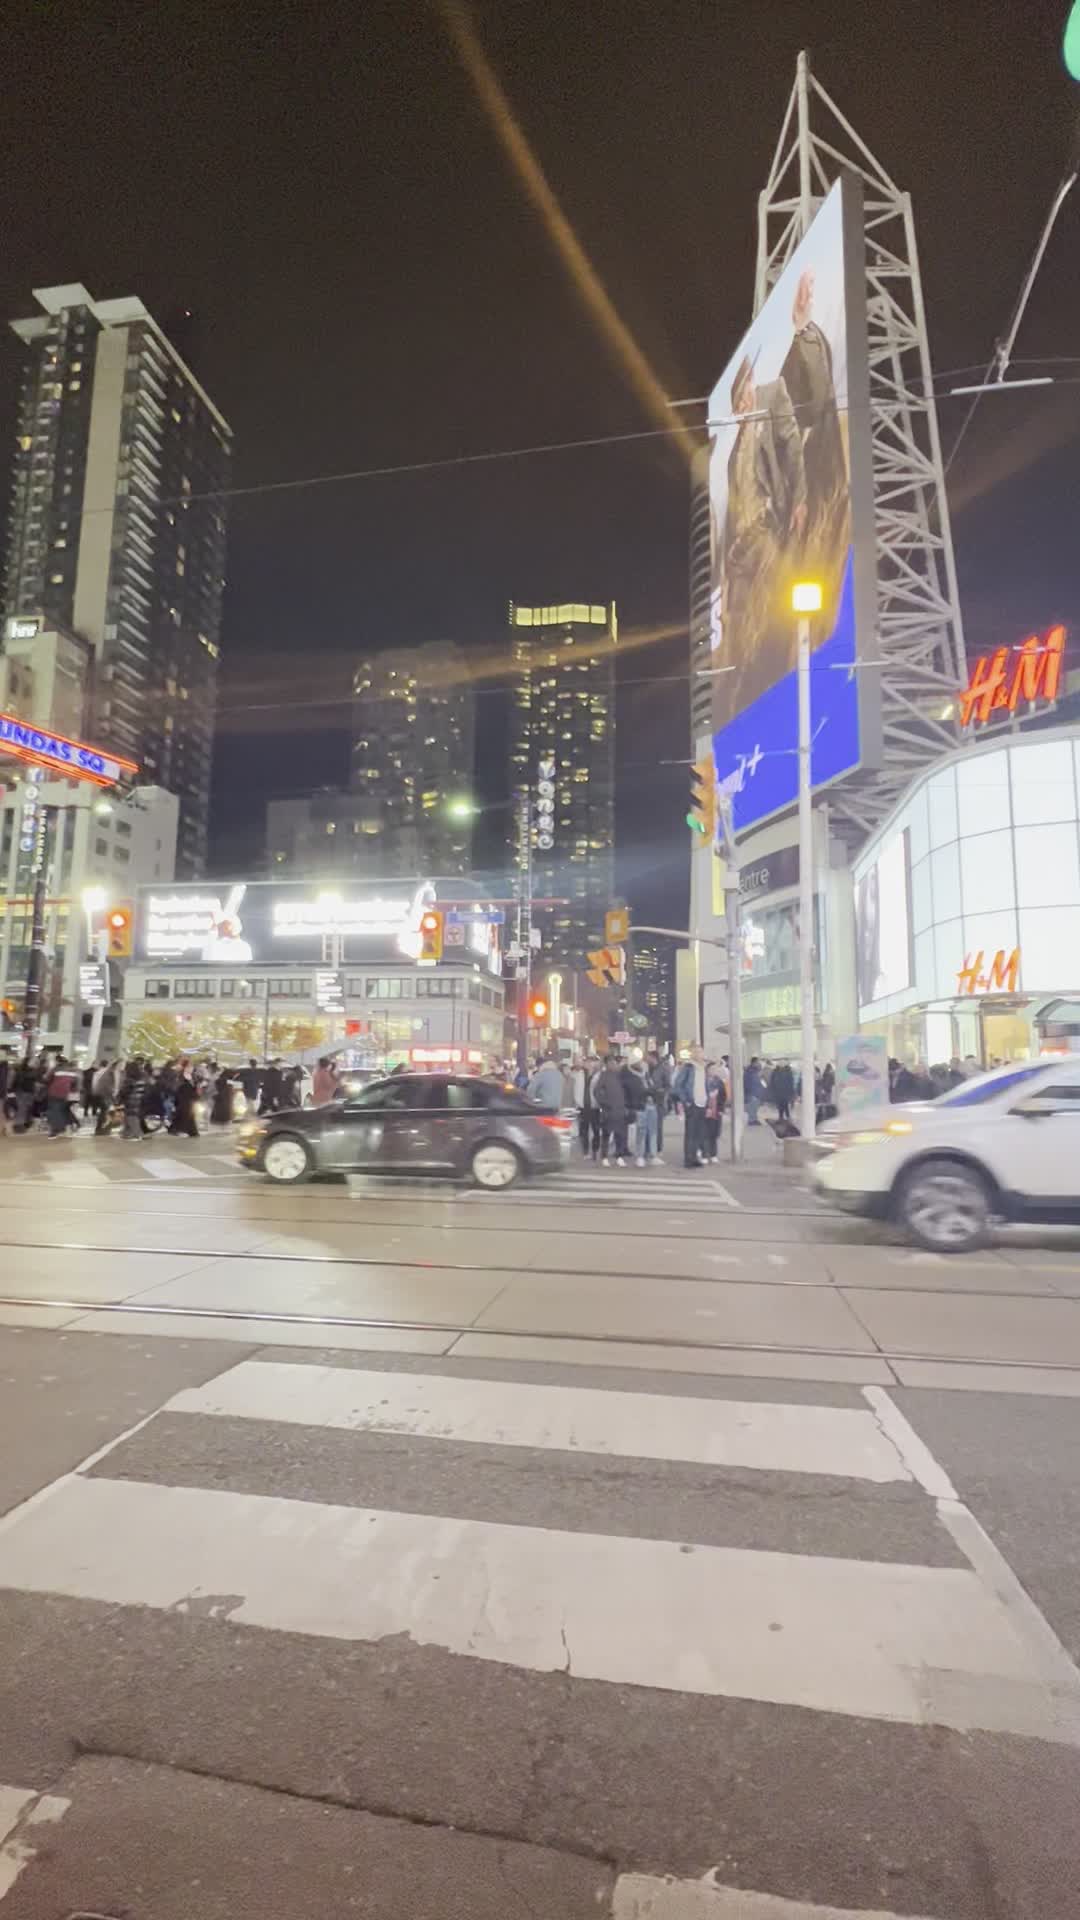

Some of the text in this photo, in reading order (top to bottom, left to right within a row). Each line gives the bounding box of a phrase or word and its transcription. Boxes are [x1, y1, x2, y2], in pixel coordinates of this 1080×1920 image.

[958, 624, 1067, 727] H&M
[78, 749, 105, 773] SQ
[955, 944, 1021, 994] H&M
